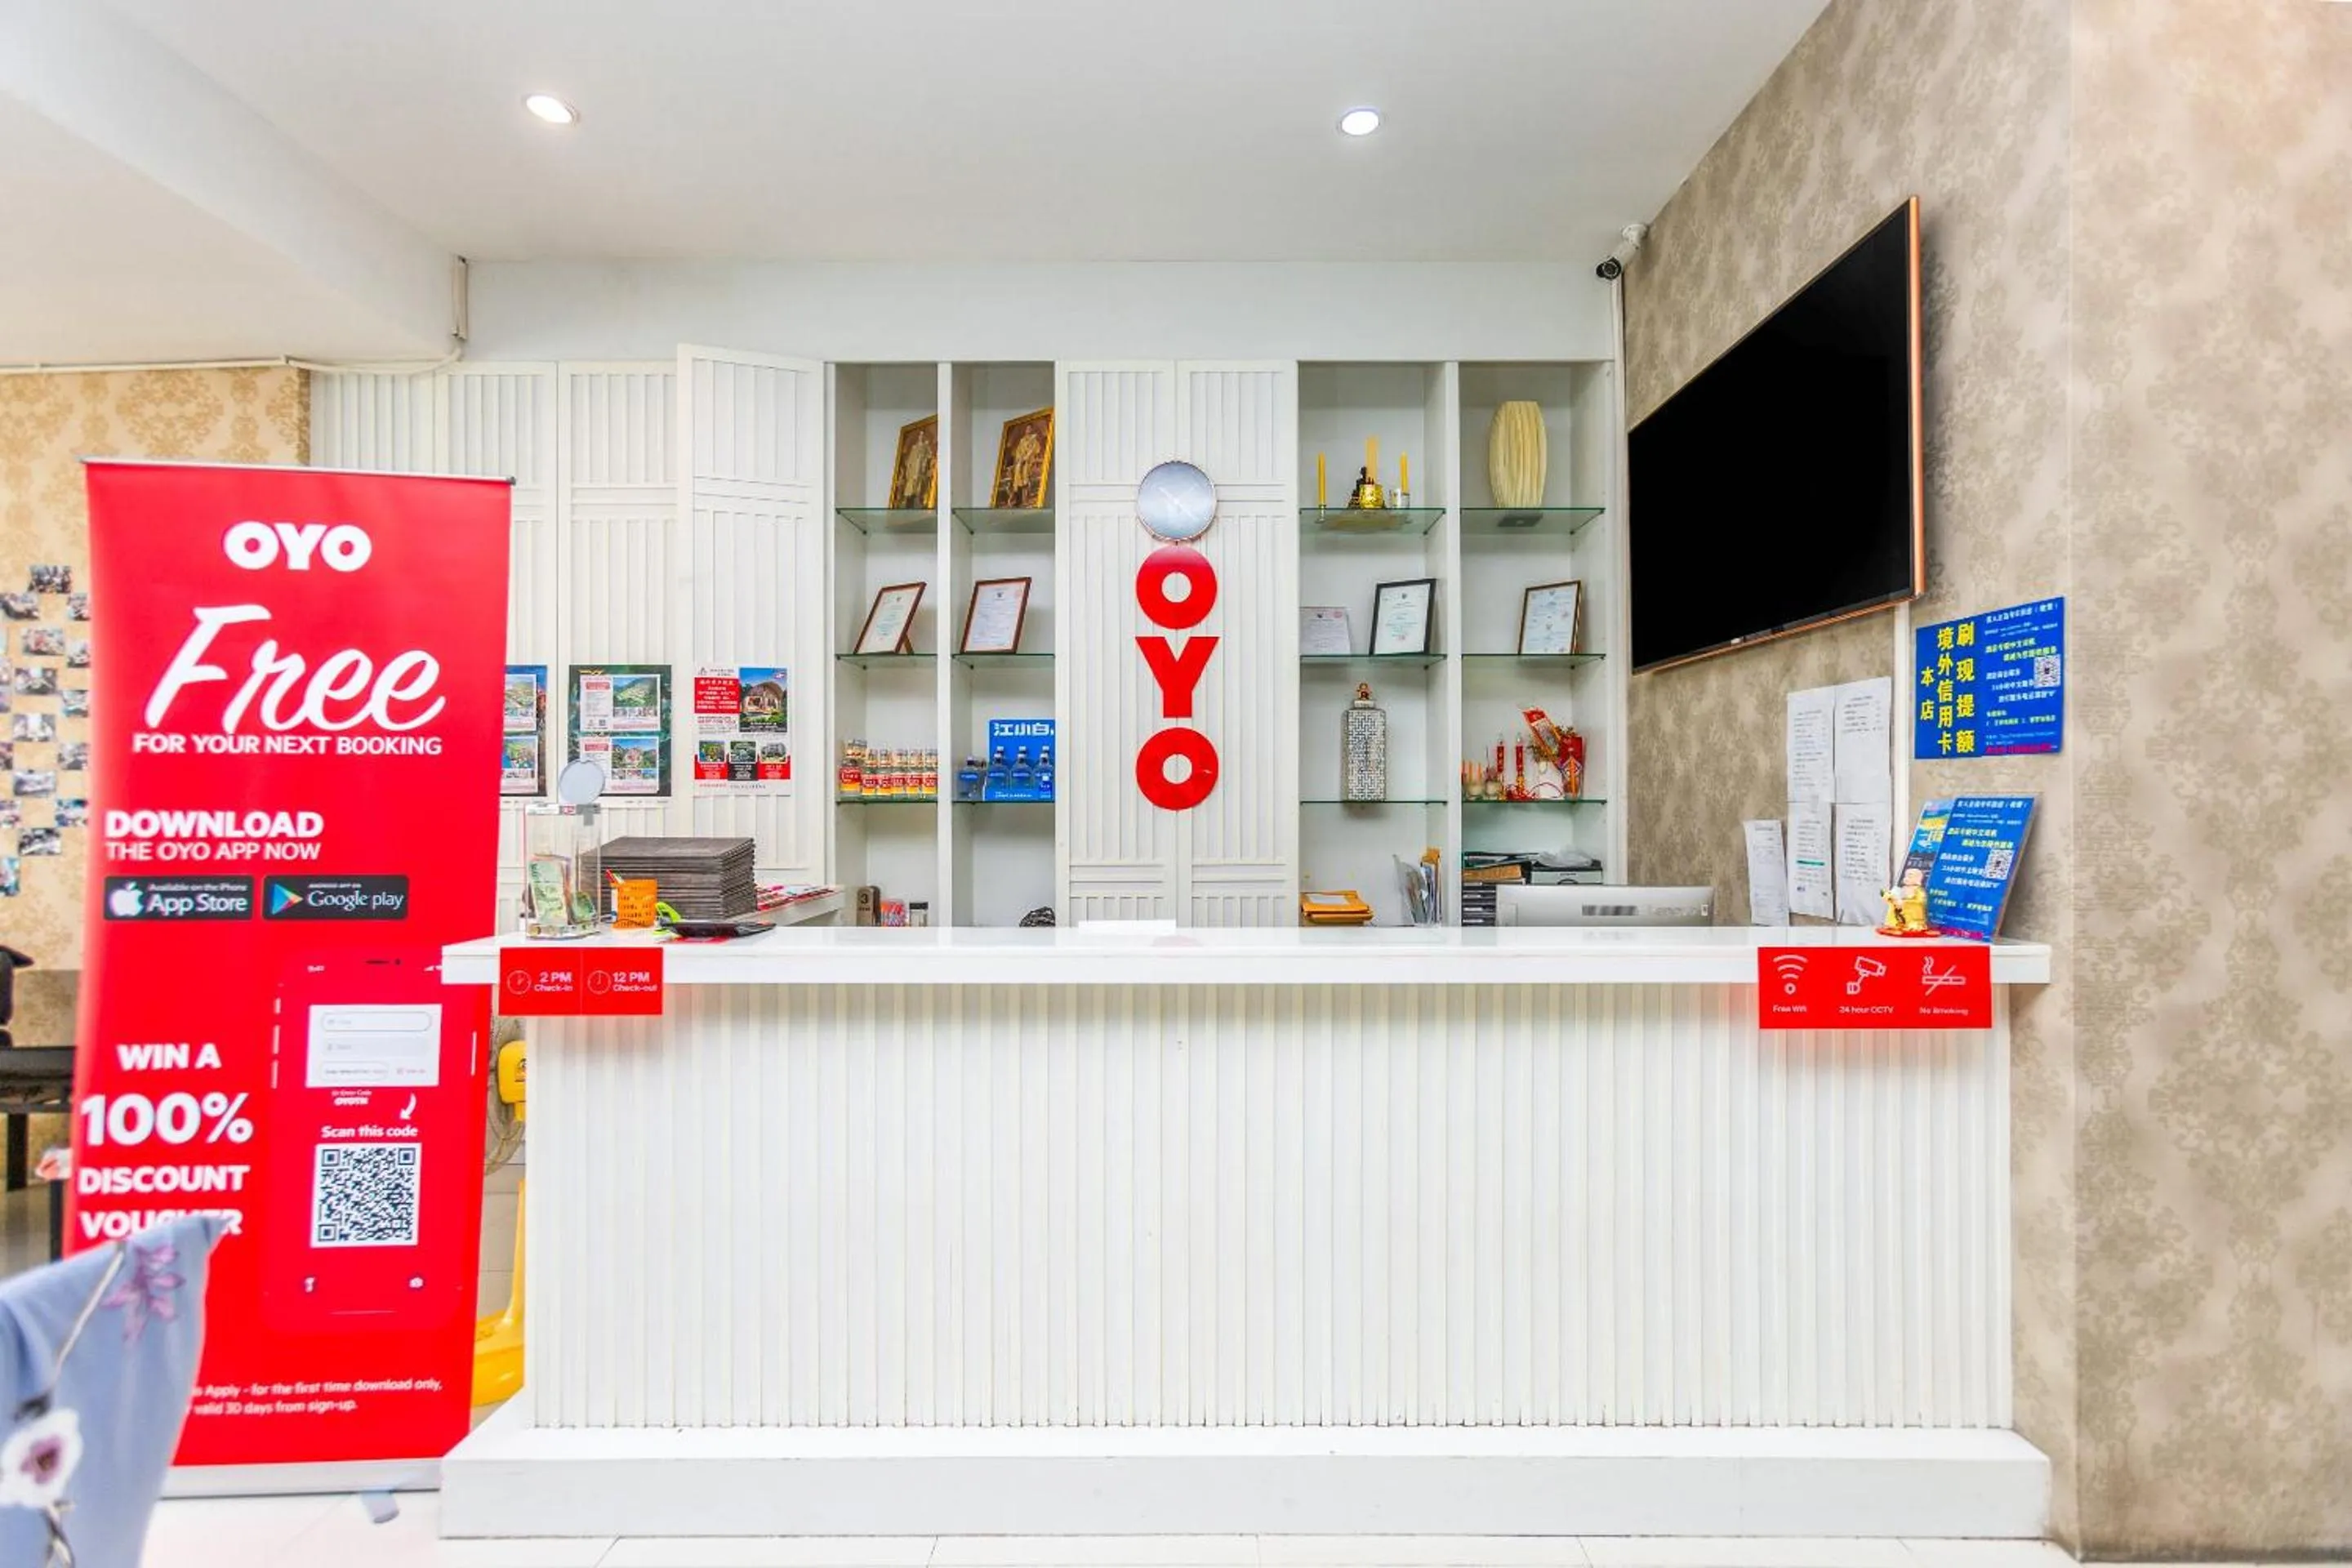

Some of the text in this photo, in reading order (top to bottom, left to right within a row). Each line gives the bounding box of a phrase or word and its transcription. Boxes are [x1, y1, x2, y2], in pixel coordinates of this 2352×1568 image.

[224, 521, 372, 572] OYO
[145, 604, 445, 734] Free
[1134, 544, 1220, 811] OYO
[1921, 666, 1934, 720] 本店
[994, 723, 1050, 736] 江小白
[133, 733, 442, 755] FOR YOUR NEXT BOOKING
[105, 811, 324, 838] DOWNLOAD
[106, 842, 321, 860] THE OYO APP NOW
[147, 893, 247, 915] App Store
[308, 890, 403, 911] Google play
[534, 984, 572, 992] Check-in
[539, 972, 572, 982] 2 PM
[613, 972, 650, 982] 12 PM
[613, 984, 657, 992] Check-out
[117, 1043, 221, 1071] WIN A
[80, 1092, 253, 1146] 100%
[321, 1125, 418, 1138] Scan this code
[78, 1165, 250, 1195] DISCOUNT
[79, 1209, 243, 1240] VOUR
[205, 1384, 240, 1397] Apply
[251, 1382, 268, 1395] for
[294, 1381, 319, 1394] first
[323, 1381, 351, 1393] time
[353, 1379, 412, 1392] download
[194, 1401, 223, 1414] valid
[225, 1402, 242, 1414] 30
[244, 1402, 273, 1416] days
[275, 1401, 305, 1413] from
